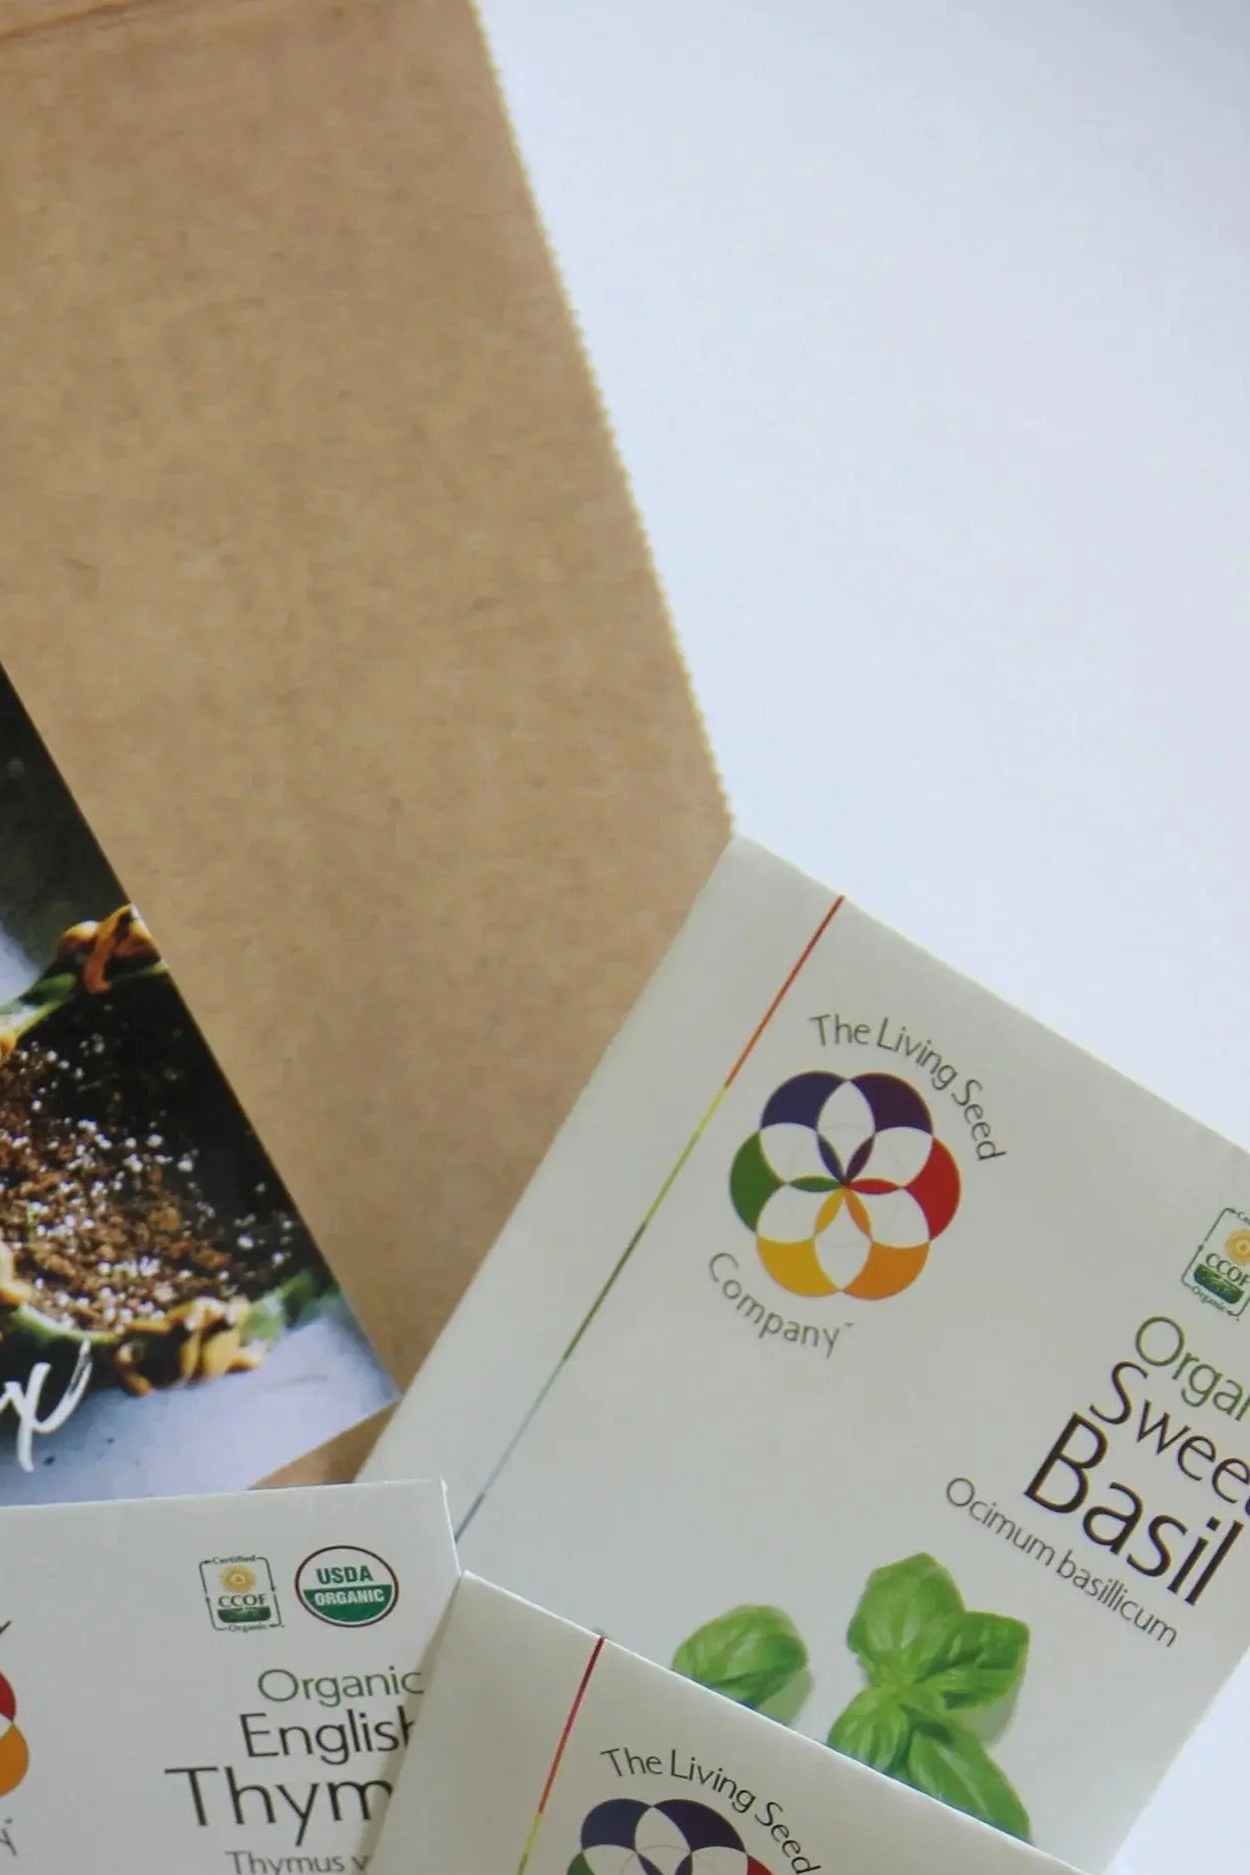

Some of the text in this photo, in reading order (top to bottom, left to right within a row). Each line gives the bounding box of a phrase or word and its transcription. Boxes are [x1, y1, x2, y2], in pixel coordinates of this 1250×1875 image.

[809, 1013, 1007, 1162] The Living Seed
[1135, 1315, 1250, 1423] Orga
[1089, 1360, 1250, 1517] Swee
[944, 1476, 1179, 1648] Ocimum basillicum
[1022, 1410, 1244, 1607] Basil
[217, 1593, 271, 1608] CCOF
[314, 1588, 385, 1606] ORGANIC
[316, 1565, 374, 1585] USDA
[257, 1665, 425, 1708] Organic
[164, 1766, 393, 1848] Thym
[600, 1747, 822, 1875] The Living Seed
